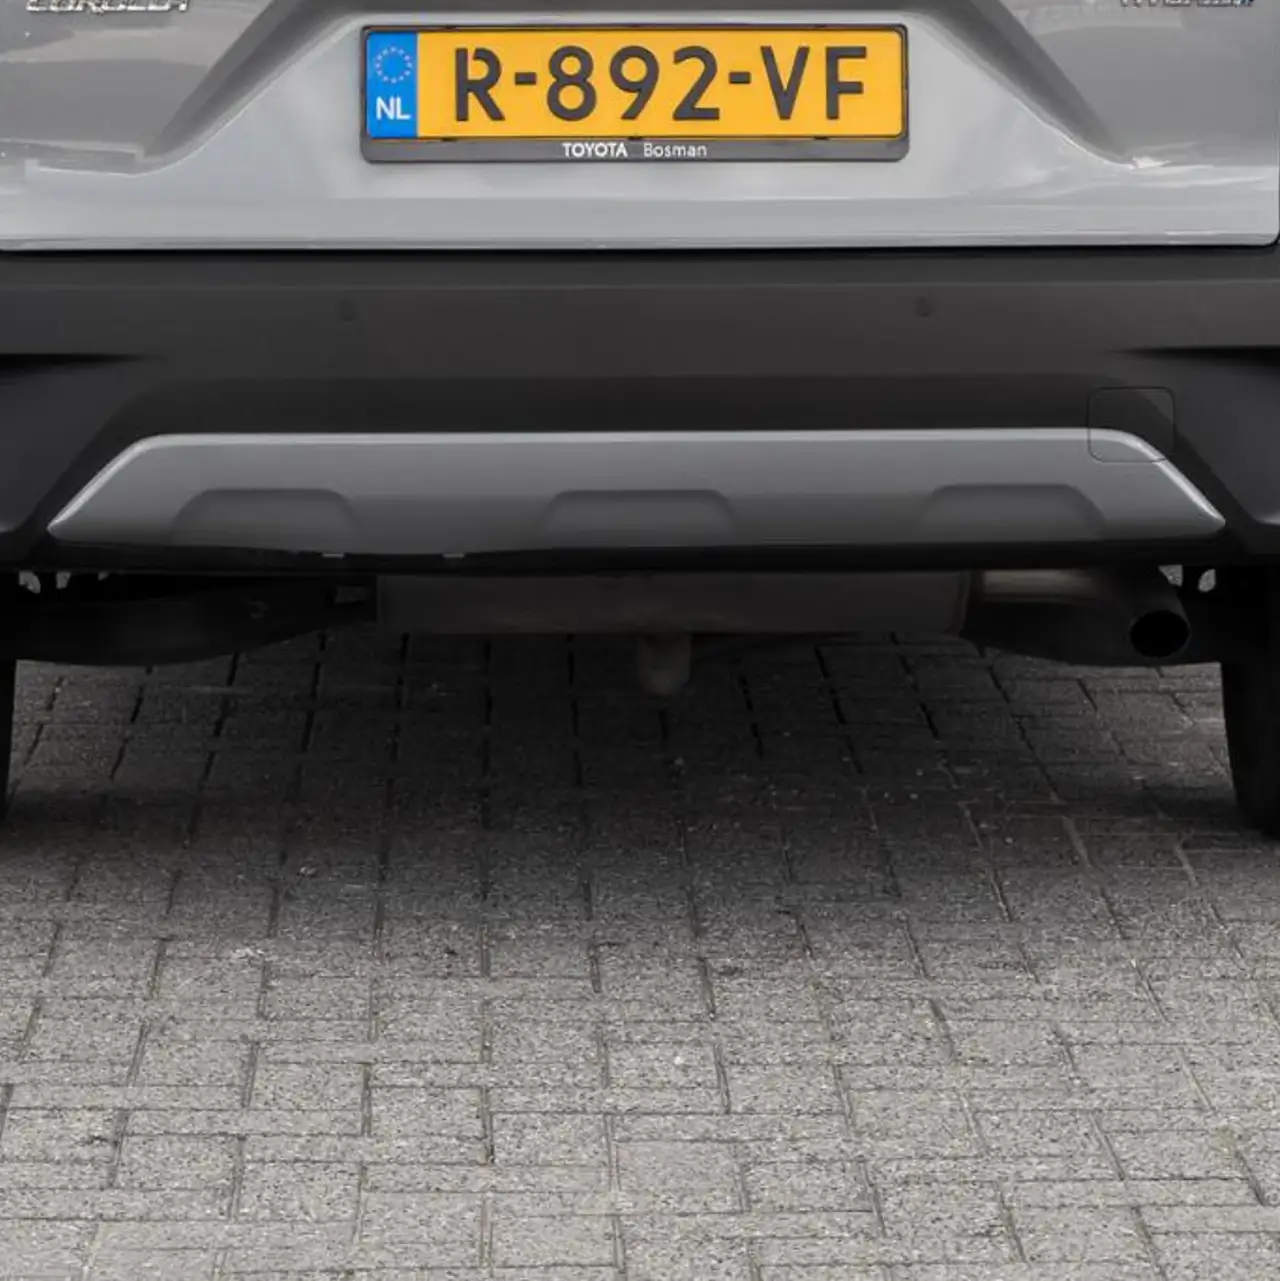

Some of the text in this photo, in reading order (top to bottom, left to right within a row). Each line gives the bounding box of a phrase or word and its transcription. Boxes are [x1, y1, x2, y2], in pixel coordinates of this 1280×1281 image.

[454, 45, 869, 122] R-892-VF
[375, 96, 412, 120] NL
[561, 141, 708, 158] TOYOTA Bosman
